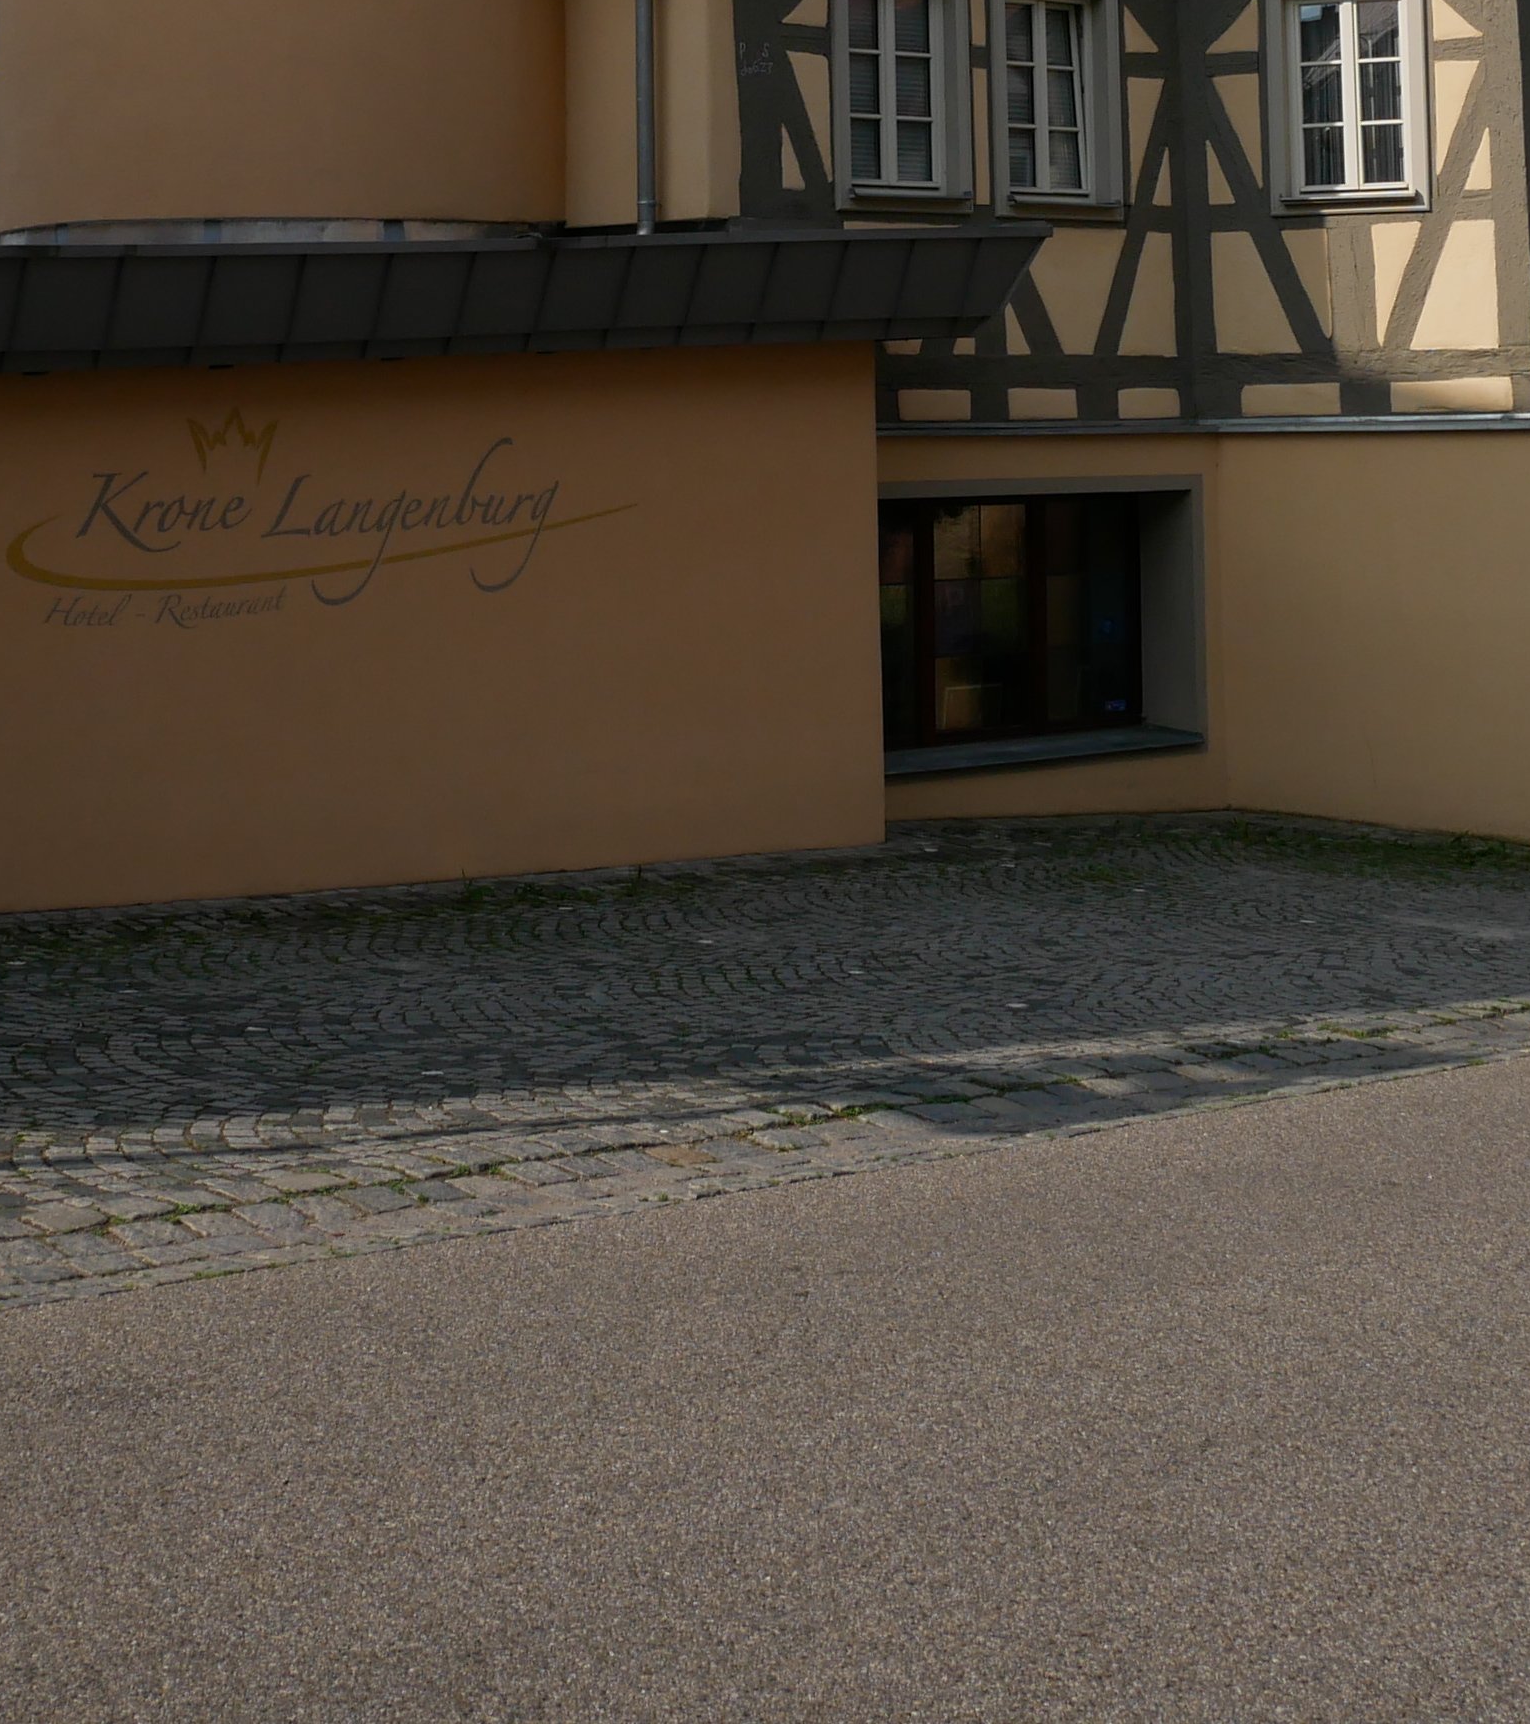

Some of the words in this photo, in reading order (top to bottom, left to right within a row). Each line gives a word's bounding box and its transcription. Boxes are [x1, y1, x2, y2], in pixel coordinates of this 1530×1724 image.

[75, 470, 252, 552] Krone
[262, 437, 559, 605] Langenburg
[43, 593, 132, 627] Hotel
[155, 586, 287, 629] Restaurant
